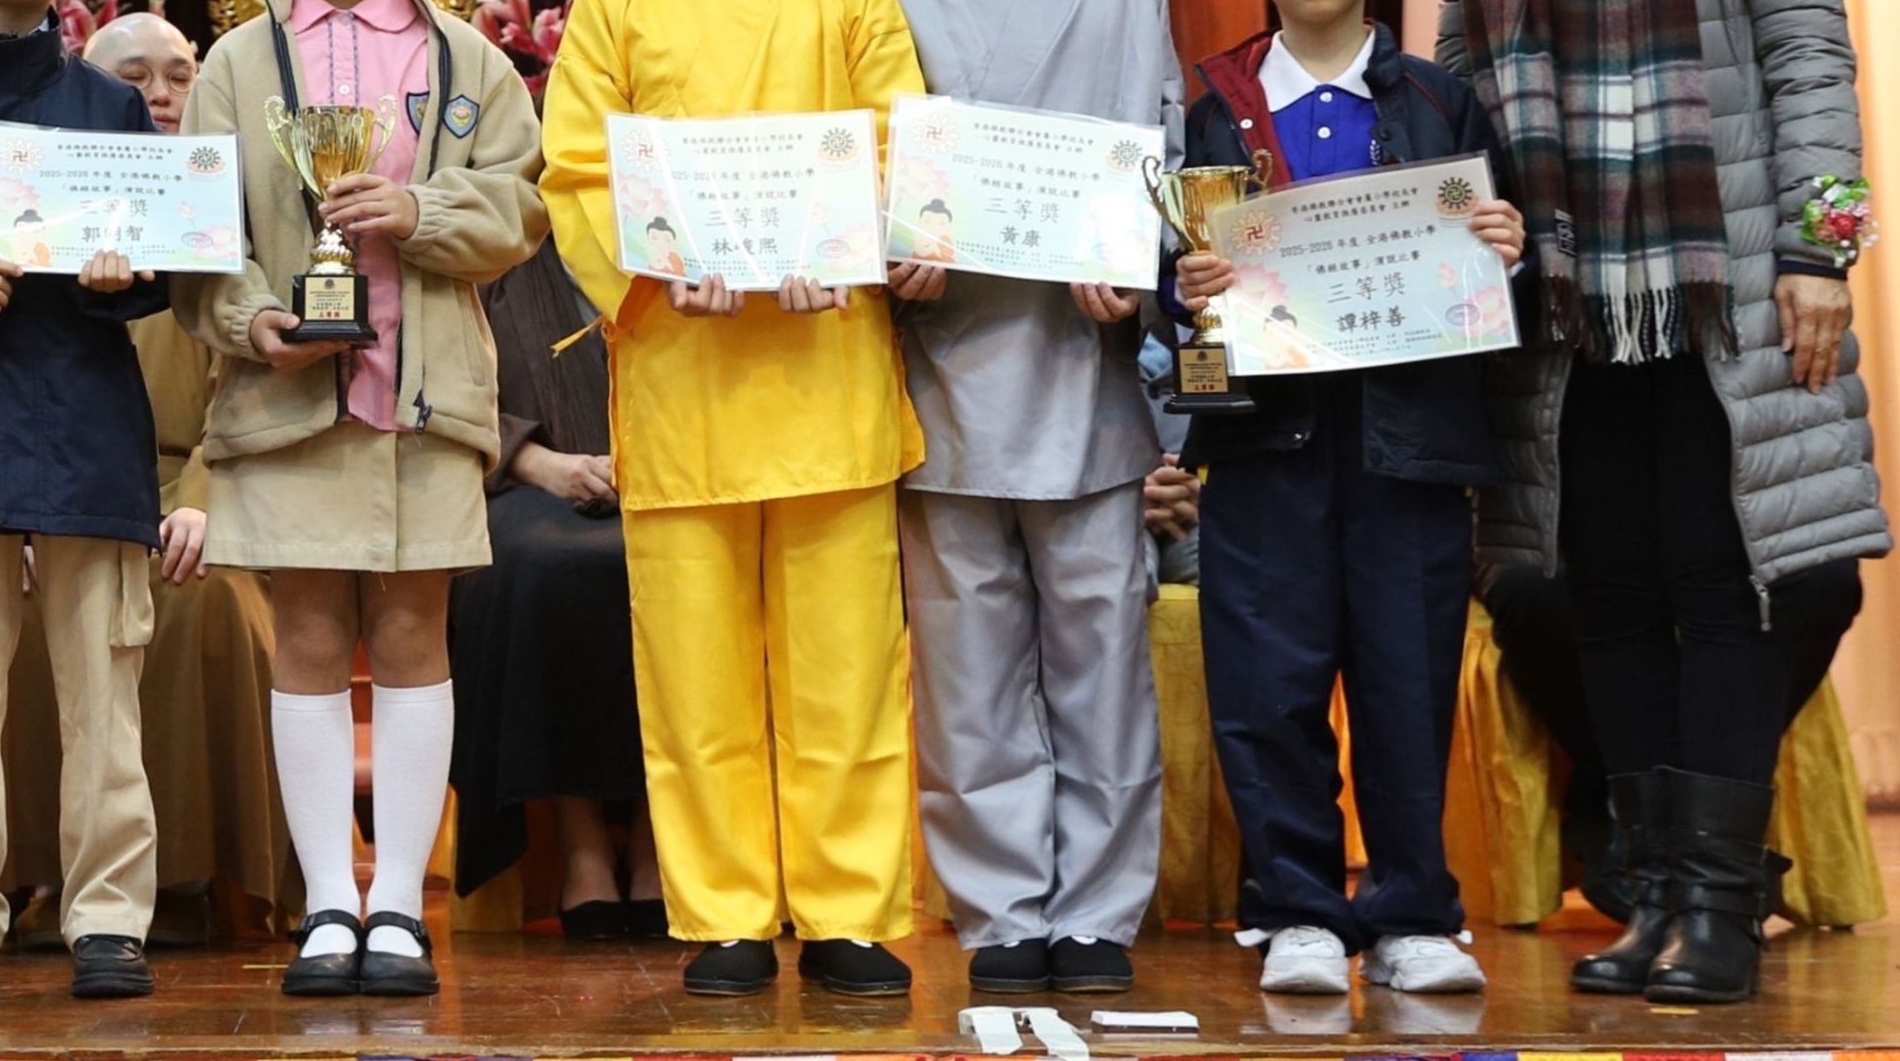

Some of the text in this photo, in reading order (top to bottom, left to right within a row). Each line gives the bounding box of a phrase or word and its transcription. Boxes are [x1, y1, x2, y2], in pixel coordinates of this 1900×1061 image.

[704, 206, 781, 229] 三等獎
[984, 197, 1060, 224] 三等獎
[1327, 271, 1405, 304] 三等獎
[1336, 304, 1406, 333] 譚梓善
